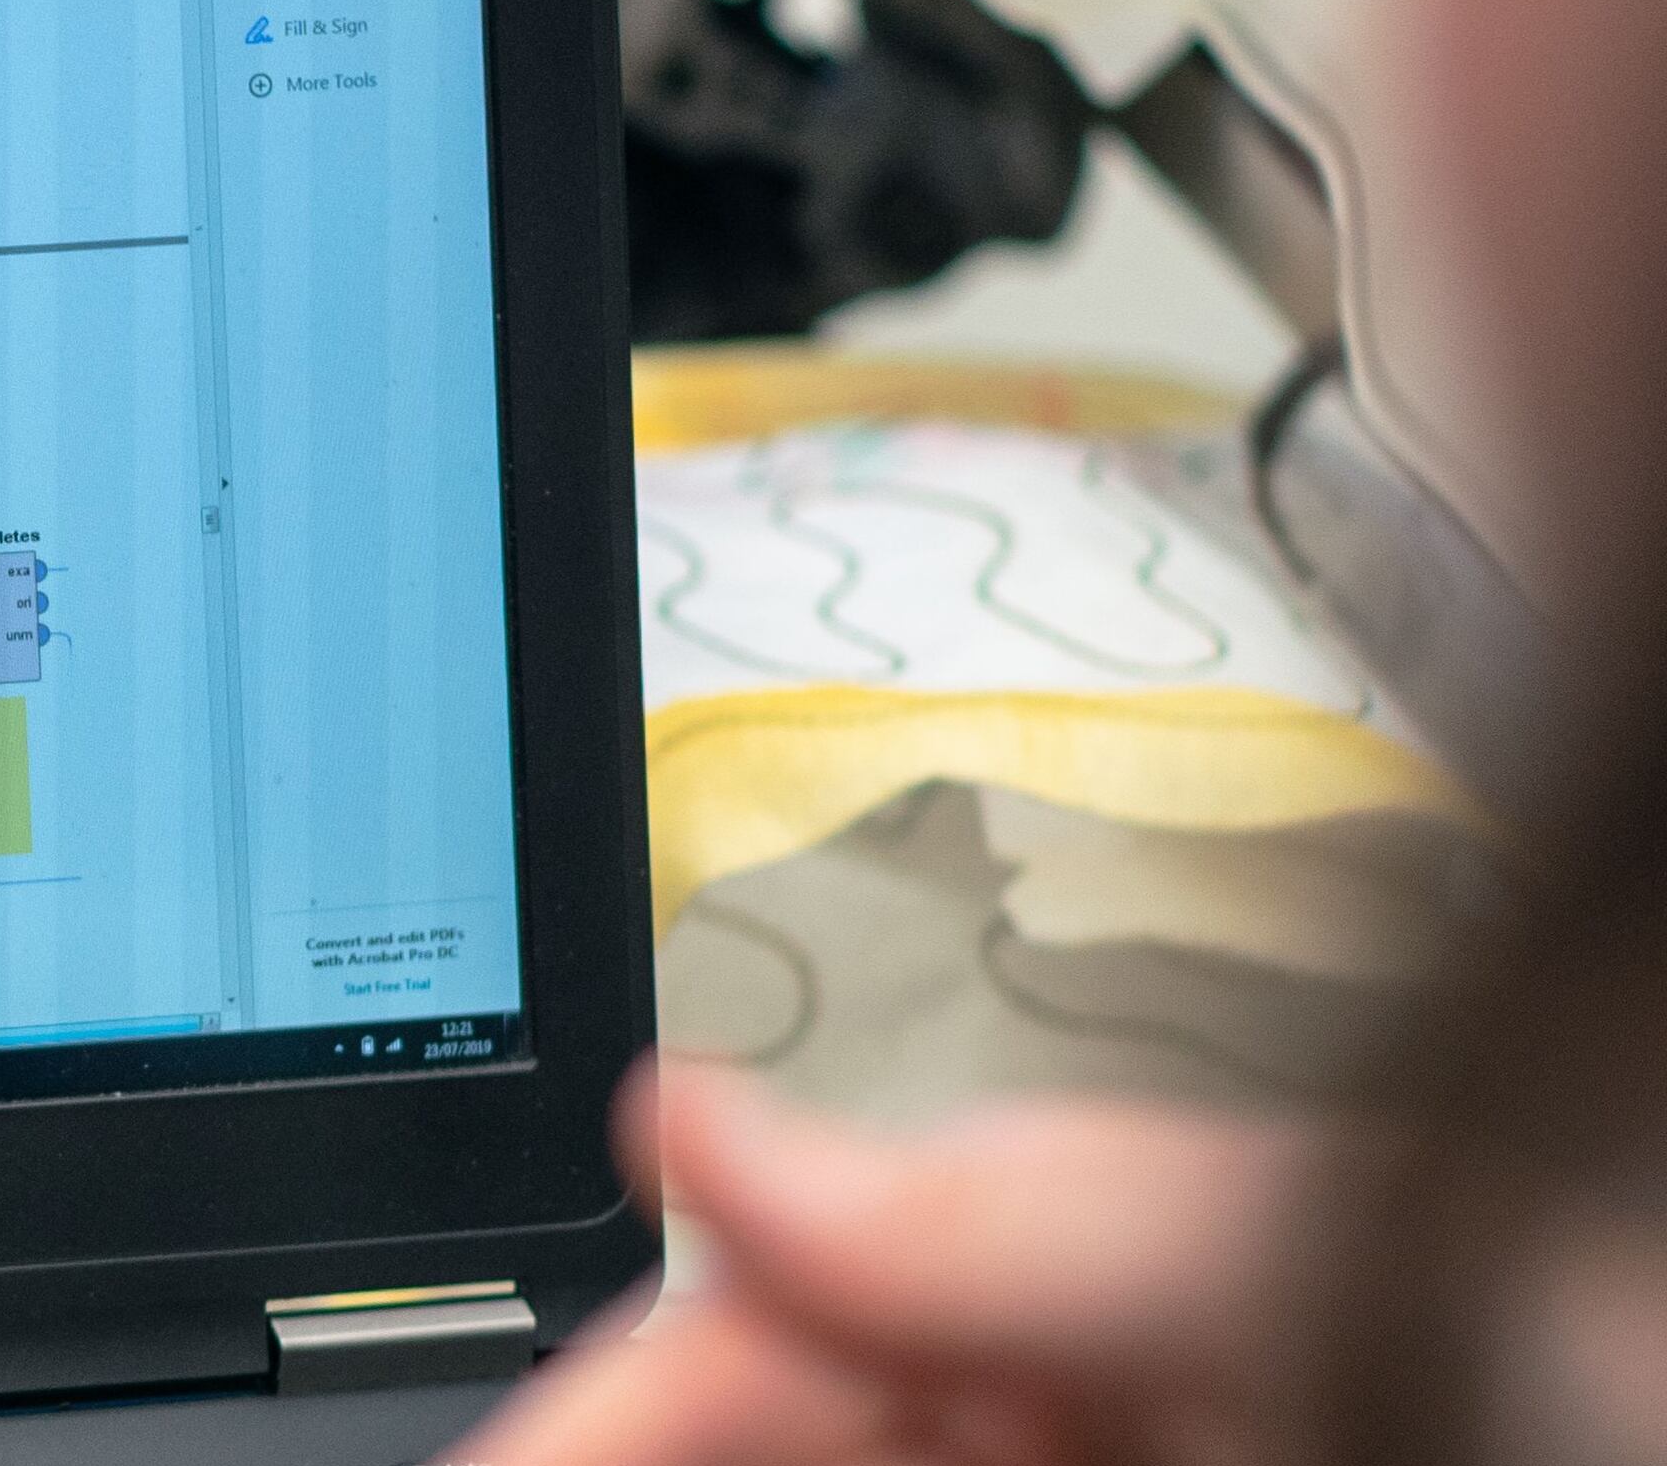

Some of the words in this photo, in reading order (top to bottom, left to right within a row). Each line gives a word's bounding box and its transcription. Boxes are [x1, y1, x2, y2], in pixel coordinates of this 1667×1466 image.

[284, 20, 307, 36] Fill
[313, 20, 327, 36] &
[331, 17, 368, 36] Sign
[286, 76, 329, 92] More
[336, 71, 378, 90] Tools
[5, 630, 34, 643] unm
[305, 936, 362, 951] Convert
[367, 933, 394, 946] and
[398, 930, 426, 944] edit
[312, 954, 344, 969] with
[348, 950, 404, 966] Acrobat
[409, 947, 433, 961] Pro
[437, 945, 460, 960] DC
[344, 981, 372, 996] Start
